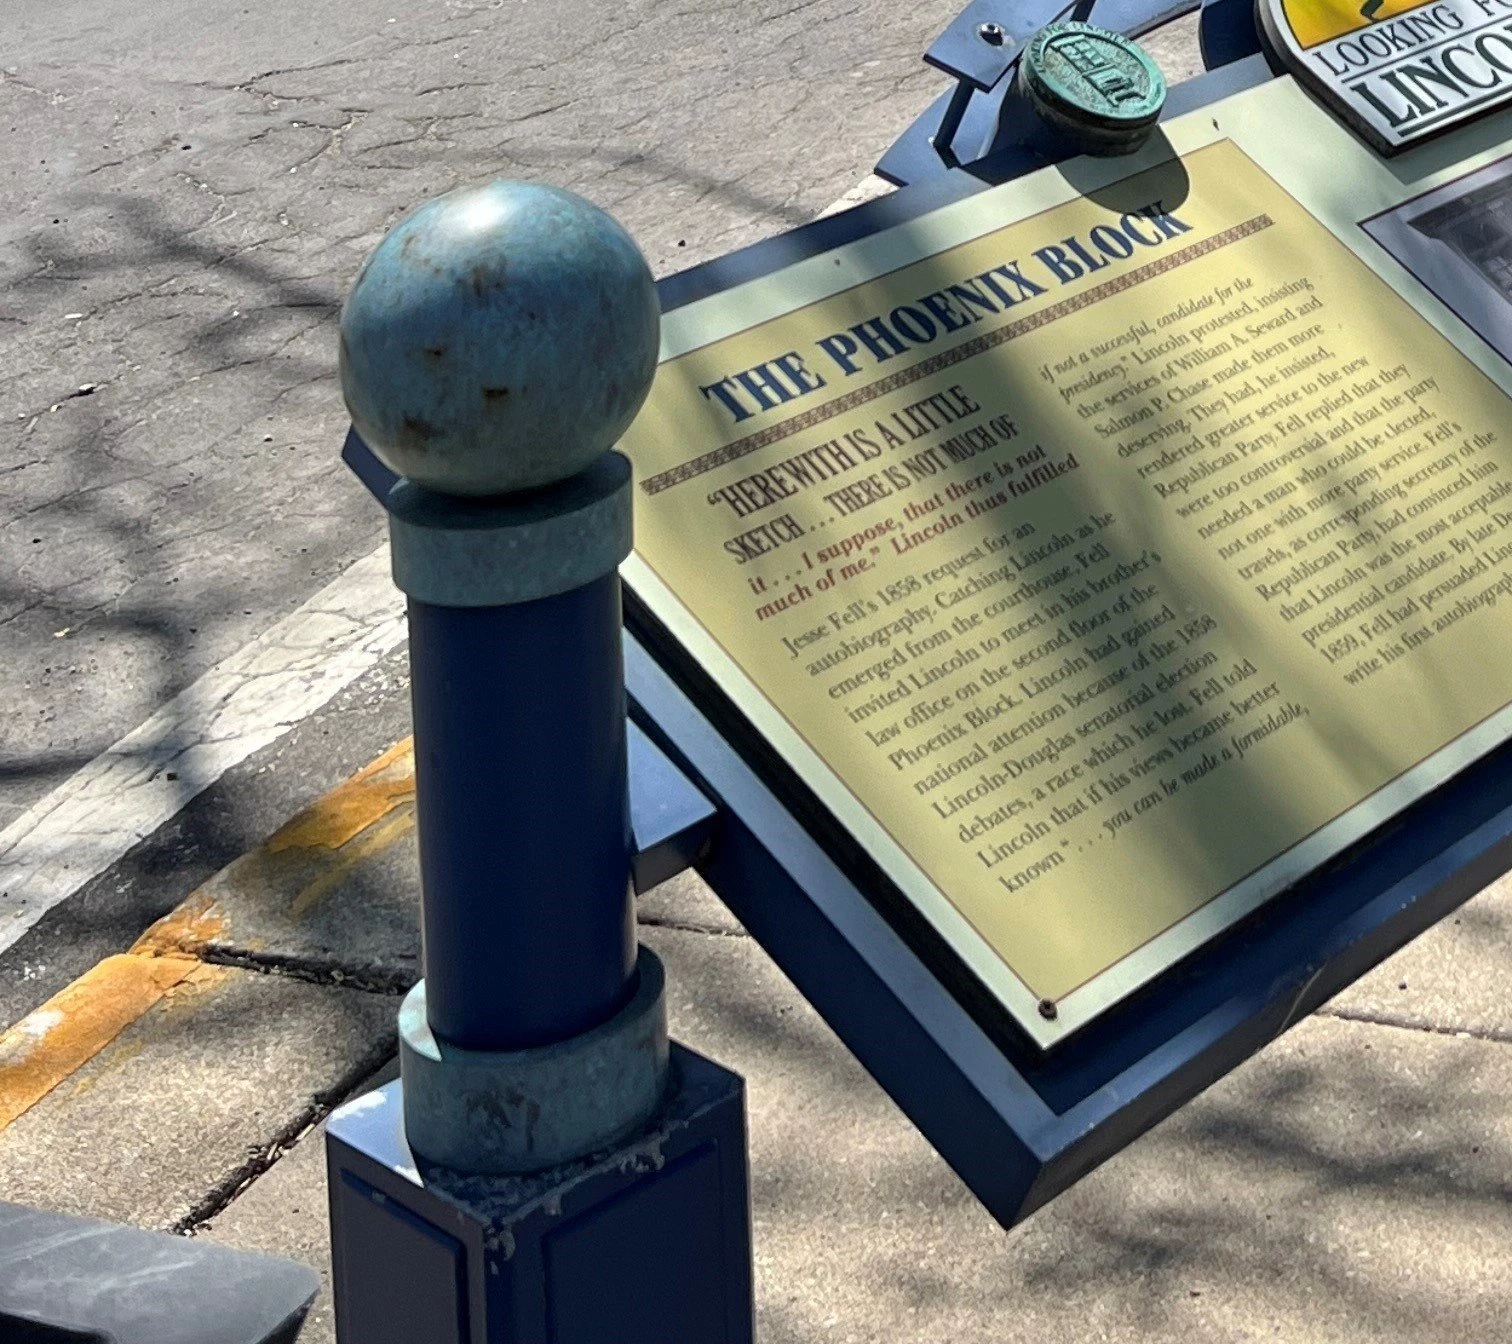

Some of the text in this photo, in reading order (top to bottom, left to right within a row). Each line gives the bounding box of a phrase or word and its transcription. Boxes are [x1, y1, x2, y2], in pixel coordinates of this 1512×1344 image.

[1310, 2, 1464, 78] LOOKING
[699, 201, 1191, 422] THE PHOENIX BLOCK
[1037, 363, 1055, 383] if
[1053, 355, 1078, 374] not
[1078, 351, 1090, 364] a
[1156, 294, 1222, 328] candidate
[1213, 286, 1233, 305] for
[1232, 277, 1253, 292] the
[707, 384, 980, 516] "HEREWITH IS A LITTLE
[723, 413, 1019, 564] SKETCH THERE IS NOT MUCH OF
[746, 443, 1046, 595] it I suppose, that there is not
[754, 452, 1079, 621] much of me." Lincoln thus fulfilled
[780, 625, 829, 658] Jesse
[876, 575, 921, 605] 1858
[922, 546, 985, 584] request
[982, 533, 1010, 553] for
[1010, 522, 1036, 540] an
[934, 565, 1016, 609] Catching
[1008, 533, 1075, 571] Lincoln
[1074, 523, 1094, 539] as
[1088, 512, 1115, 530] he
[827, 647, 907, 699] emerged
[904, 629, 952, 658] from
[951, 613, 982, 635] the
[1074, 541, 1111, 568] Fell
[843, 679, 911, 723] invited
[907, 648, 980, 689] Lincoln
[978, 637, 1001, 653] to
[1000, 612, 1046, 642] meet
[1039, 602, 1065, 619] in
[1059, 587, 1091, 609] his
[864, 584, 1158, 747] law office on the second floor of the
[887, 723, 967, 770] Phoenix
[1018, 657, 1088, 698] Lincoln
[1083, 634, 1121, 662] had
[1121, 604, 1176, 647] gained
[913, 614, 1217, 795] national attention because of the 1858
[931, 651, 1217, 818] Lincoln-Douglas senatorial election
[976, 681, 1280, 868] Lincoln that if his views became better
[1030, 786, 1047, 801] a
[1044, 764, 1083, 793] race
[1082, 733, 1134, 768] which
[1129, 720, 1157, 740] he
[1188, 677, 1224, 706] Fell
[1222, 657, 1257, 686] told
[997, 851, 1065, 893] known
